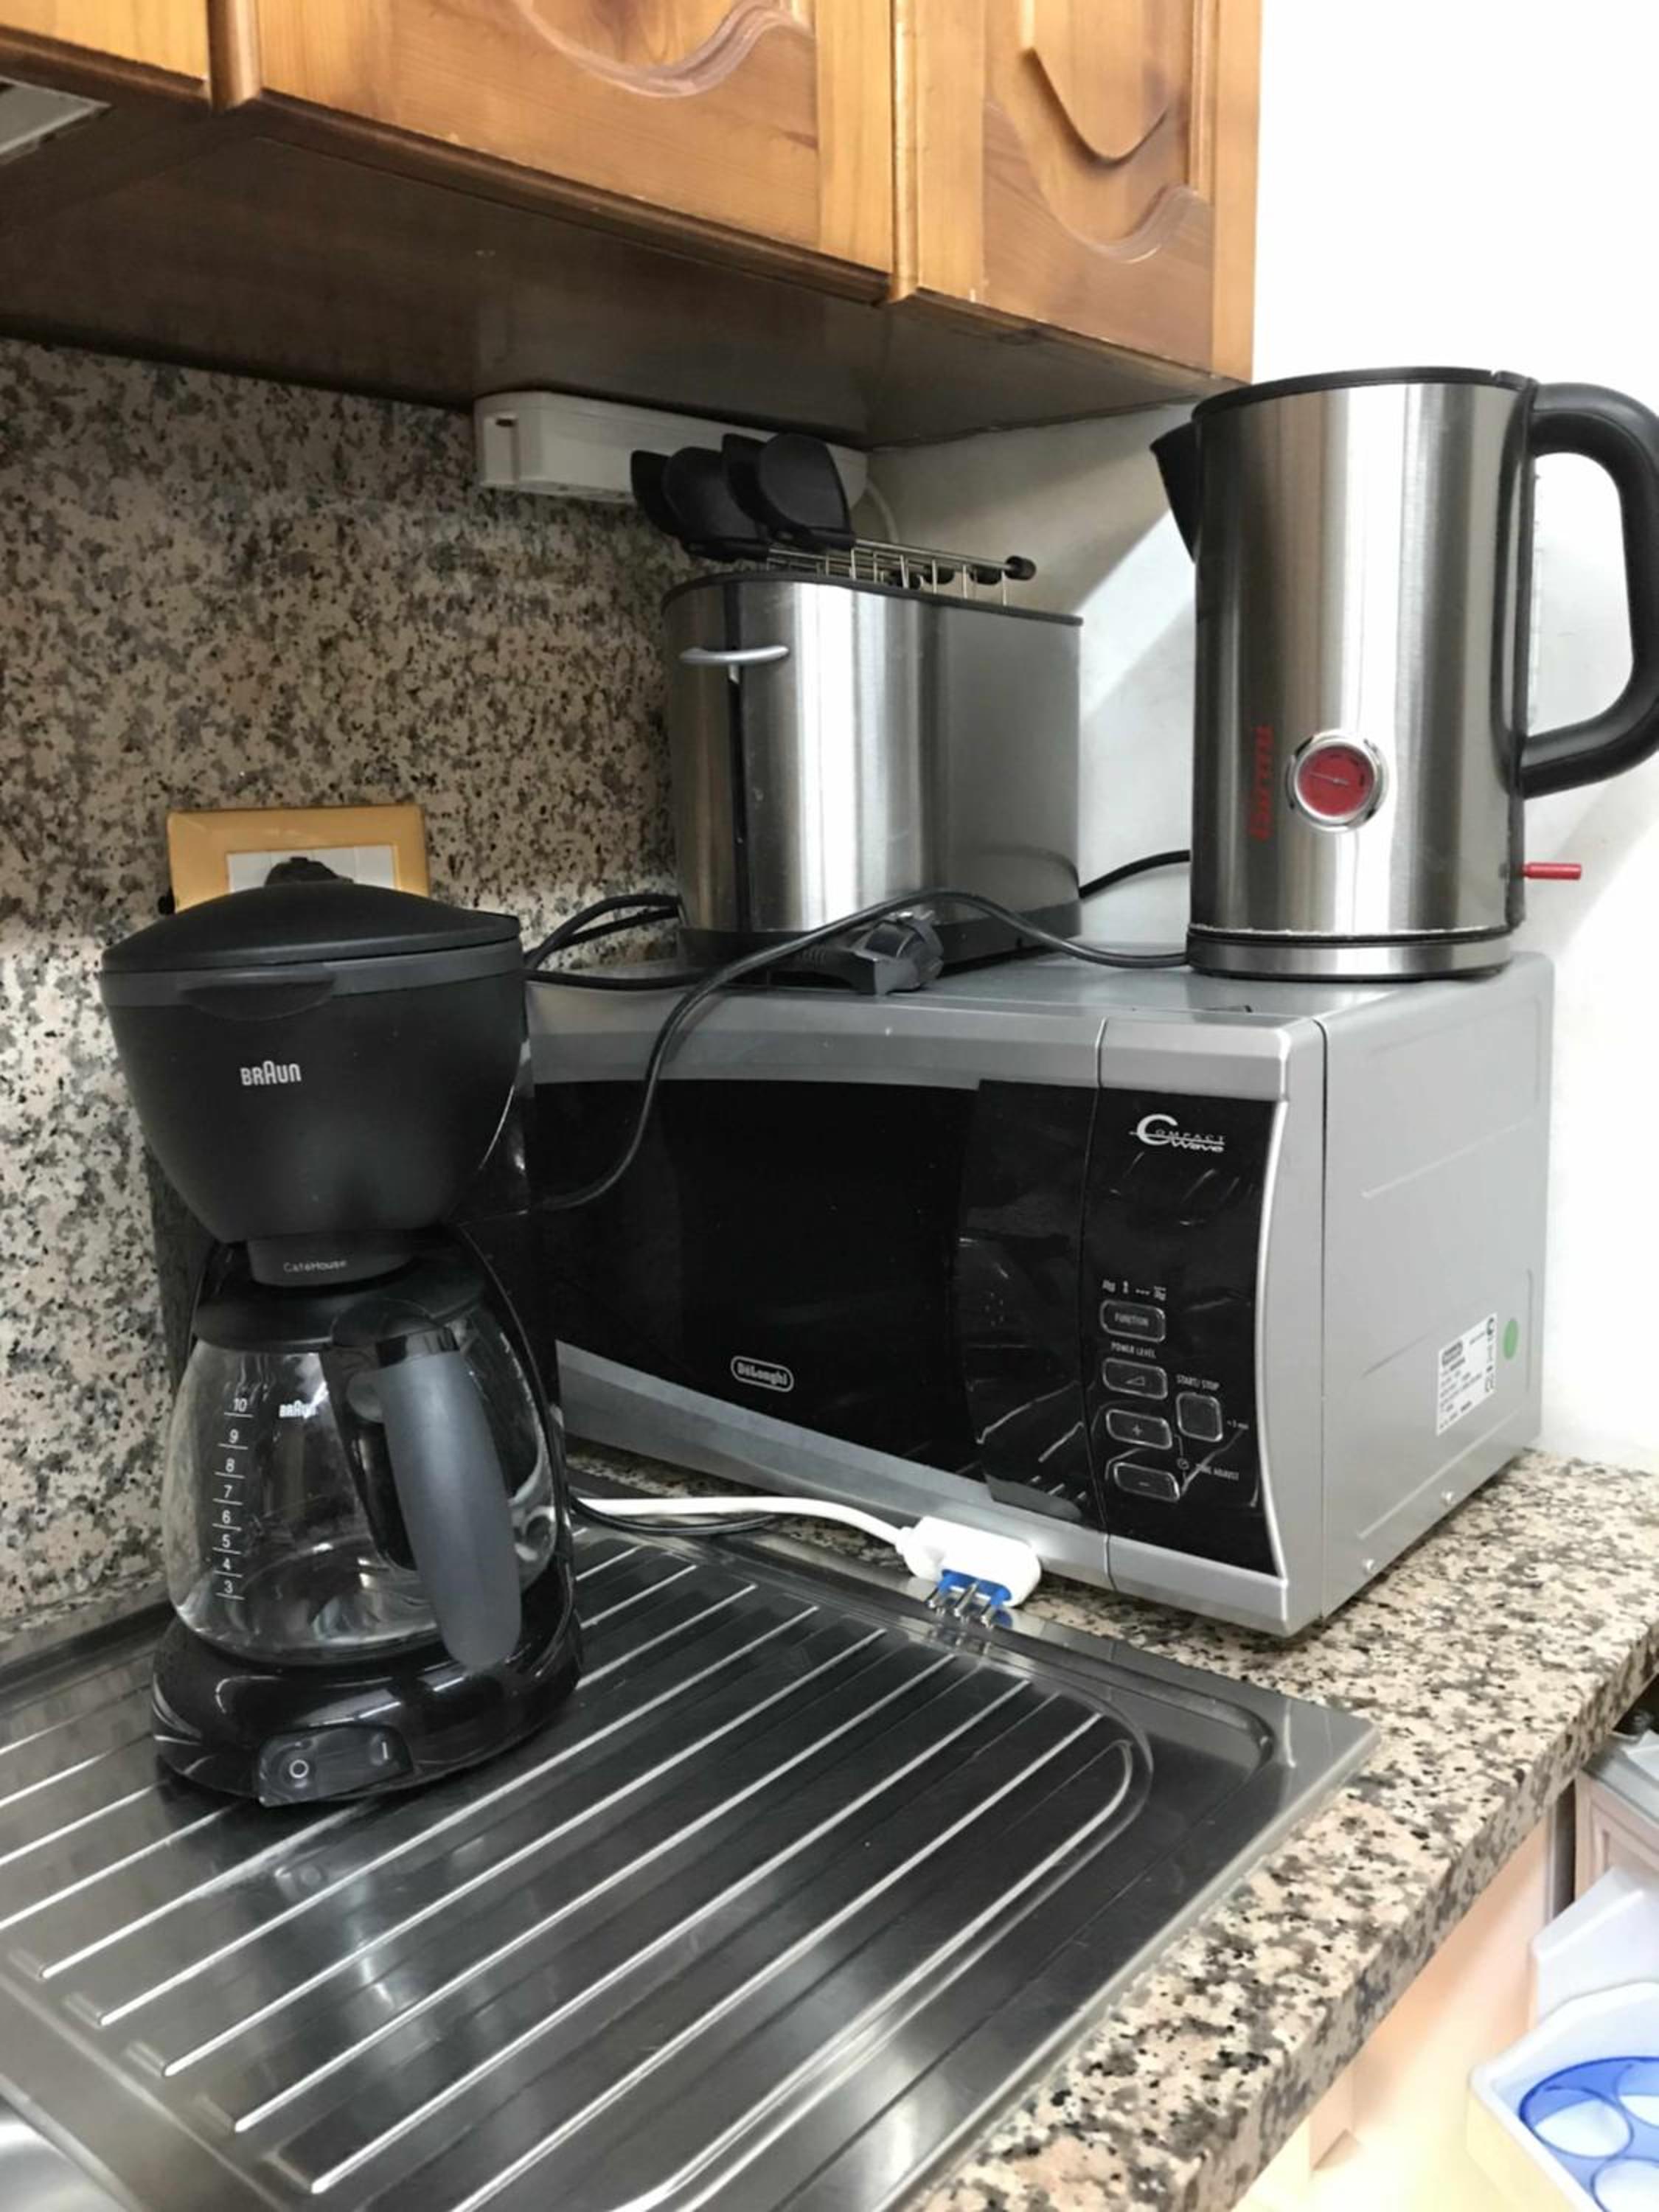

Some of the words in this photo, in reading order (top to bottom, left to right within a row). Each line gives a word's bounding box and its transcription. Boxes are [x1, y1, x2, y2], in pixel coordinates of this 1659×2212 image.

[240, 1060, 302, 1085] BRAUN
[233, 1398, 248, 1413] 10
[229, 1429, 239, 1444] 9
[226, 1458, 235, 1473] 8
[224, 1484, 232, 1498] 7
[222, 1510, 231, 1524] 6
[222, 1534, 230, 1548] 5
[223, 1558, 231, 1571] 4
[224, 1580, 233, 1594] 3
